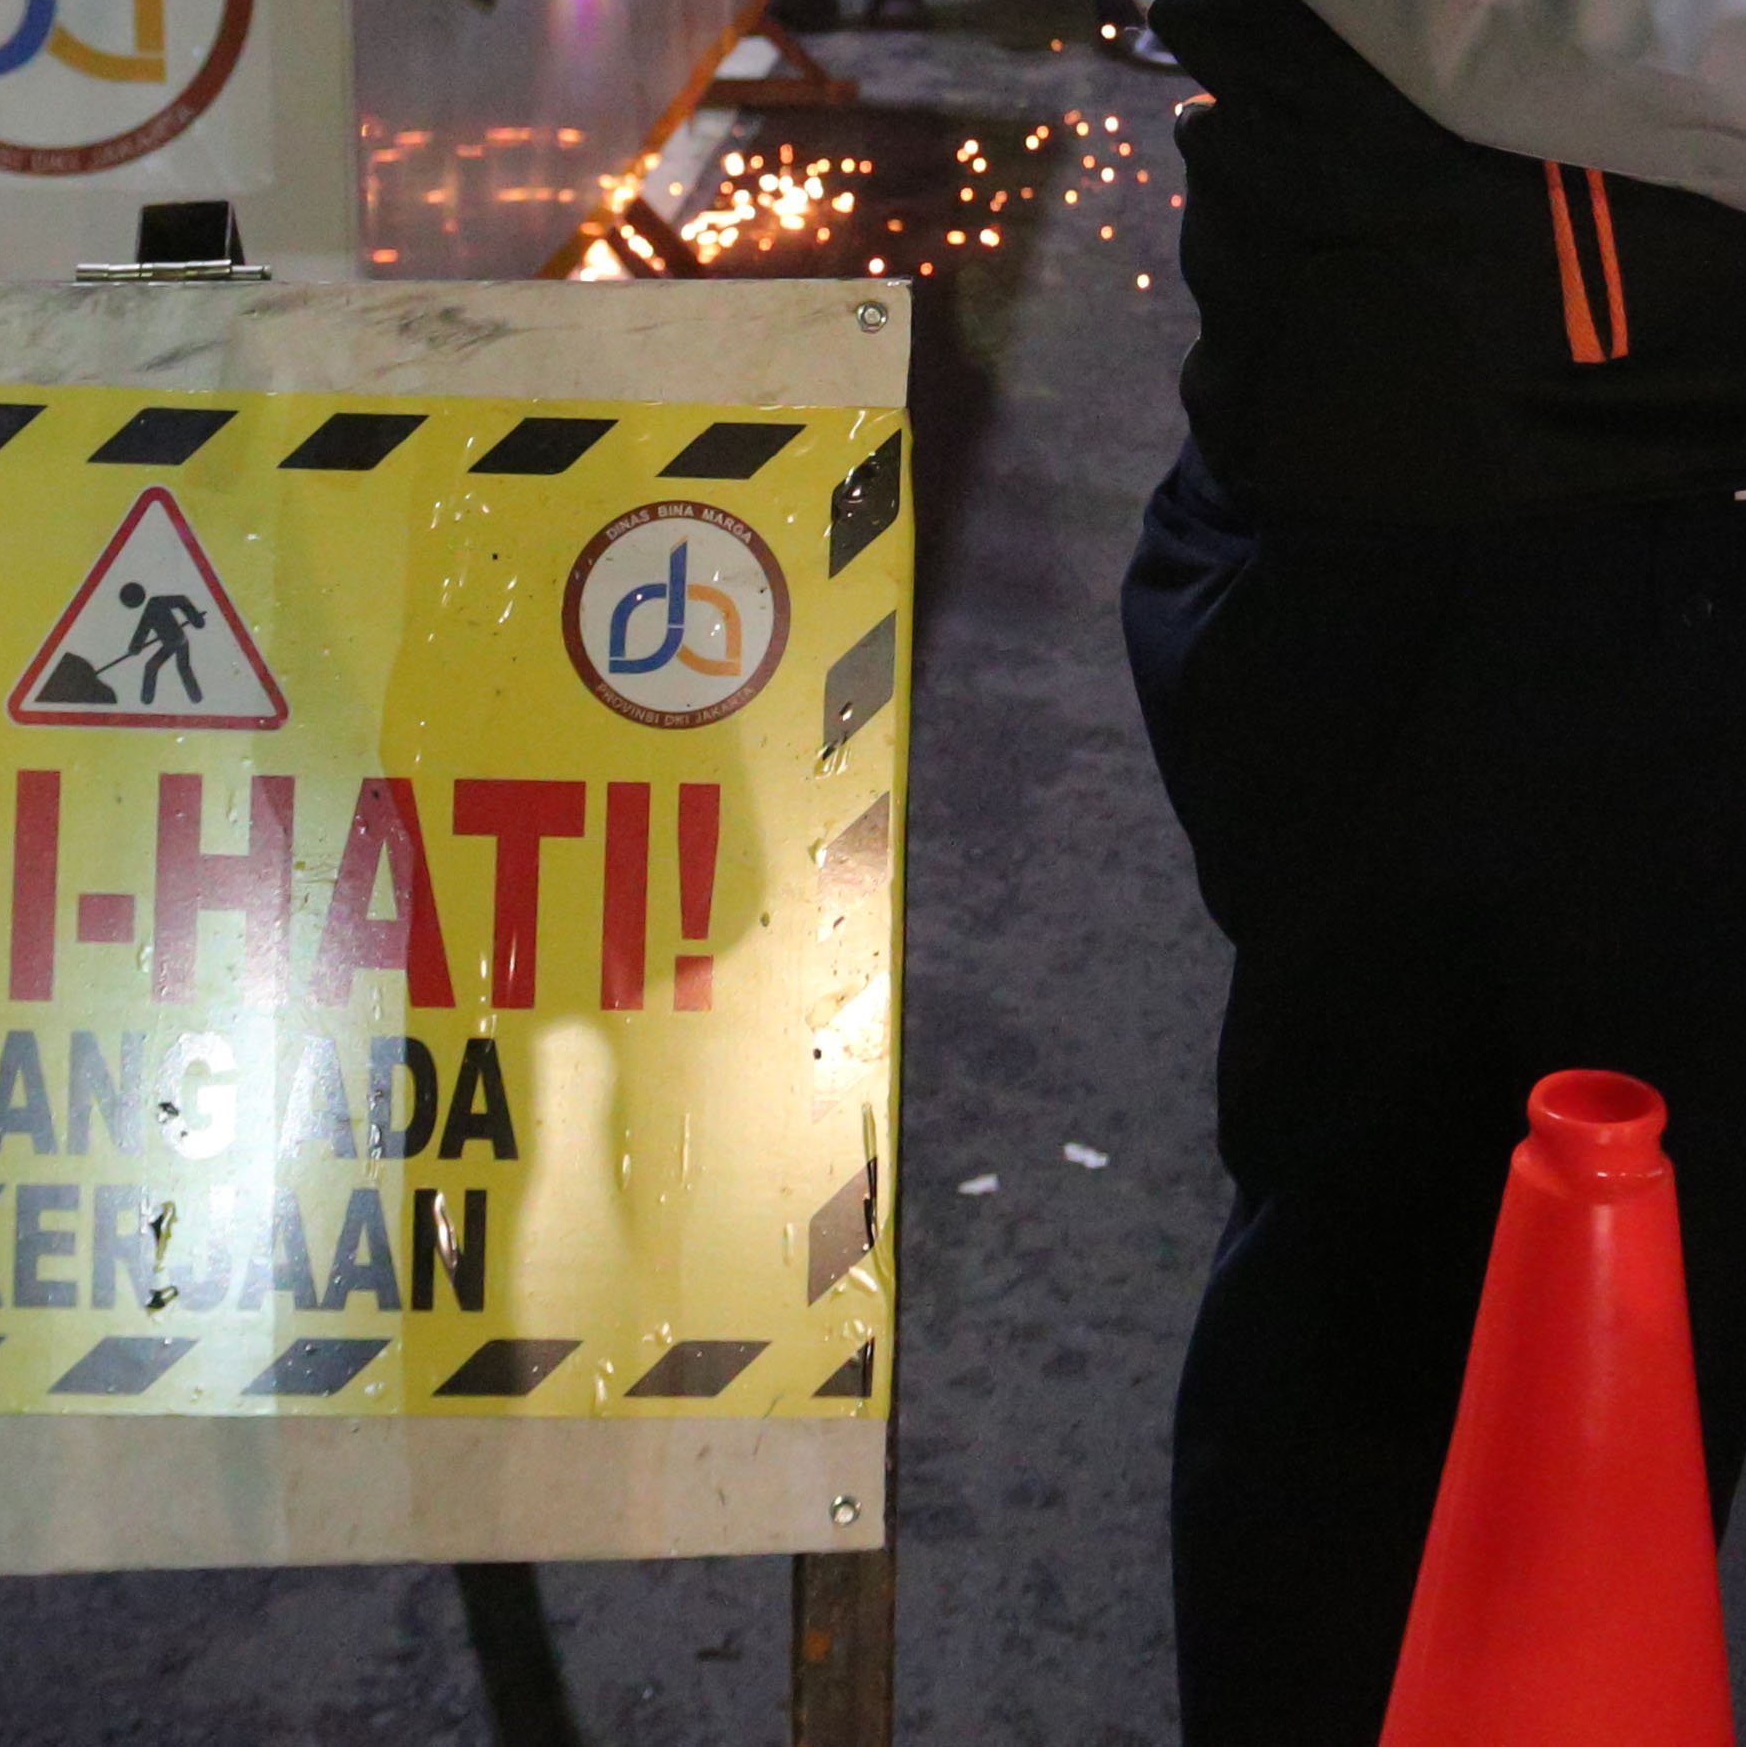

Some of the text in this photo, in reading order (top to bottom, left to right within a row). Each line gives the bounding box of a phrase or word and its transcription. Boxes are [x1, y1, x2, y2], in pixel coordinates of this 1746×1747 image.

[605, 503, 755, 545] DINAS BINA MARGA
[594, 682, 660, 726] PROVINSI
[694, 684, 755, 726] JAKARTA
[276, 1035, 520, 1161] ADA
